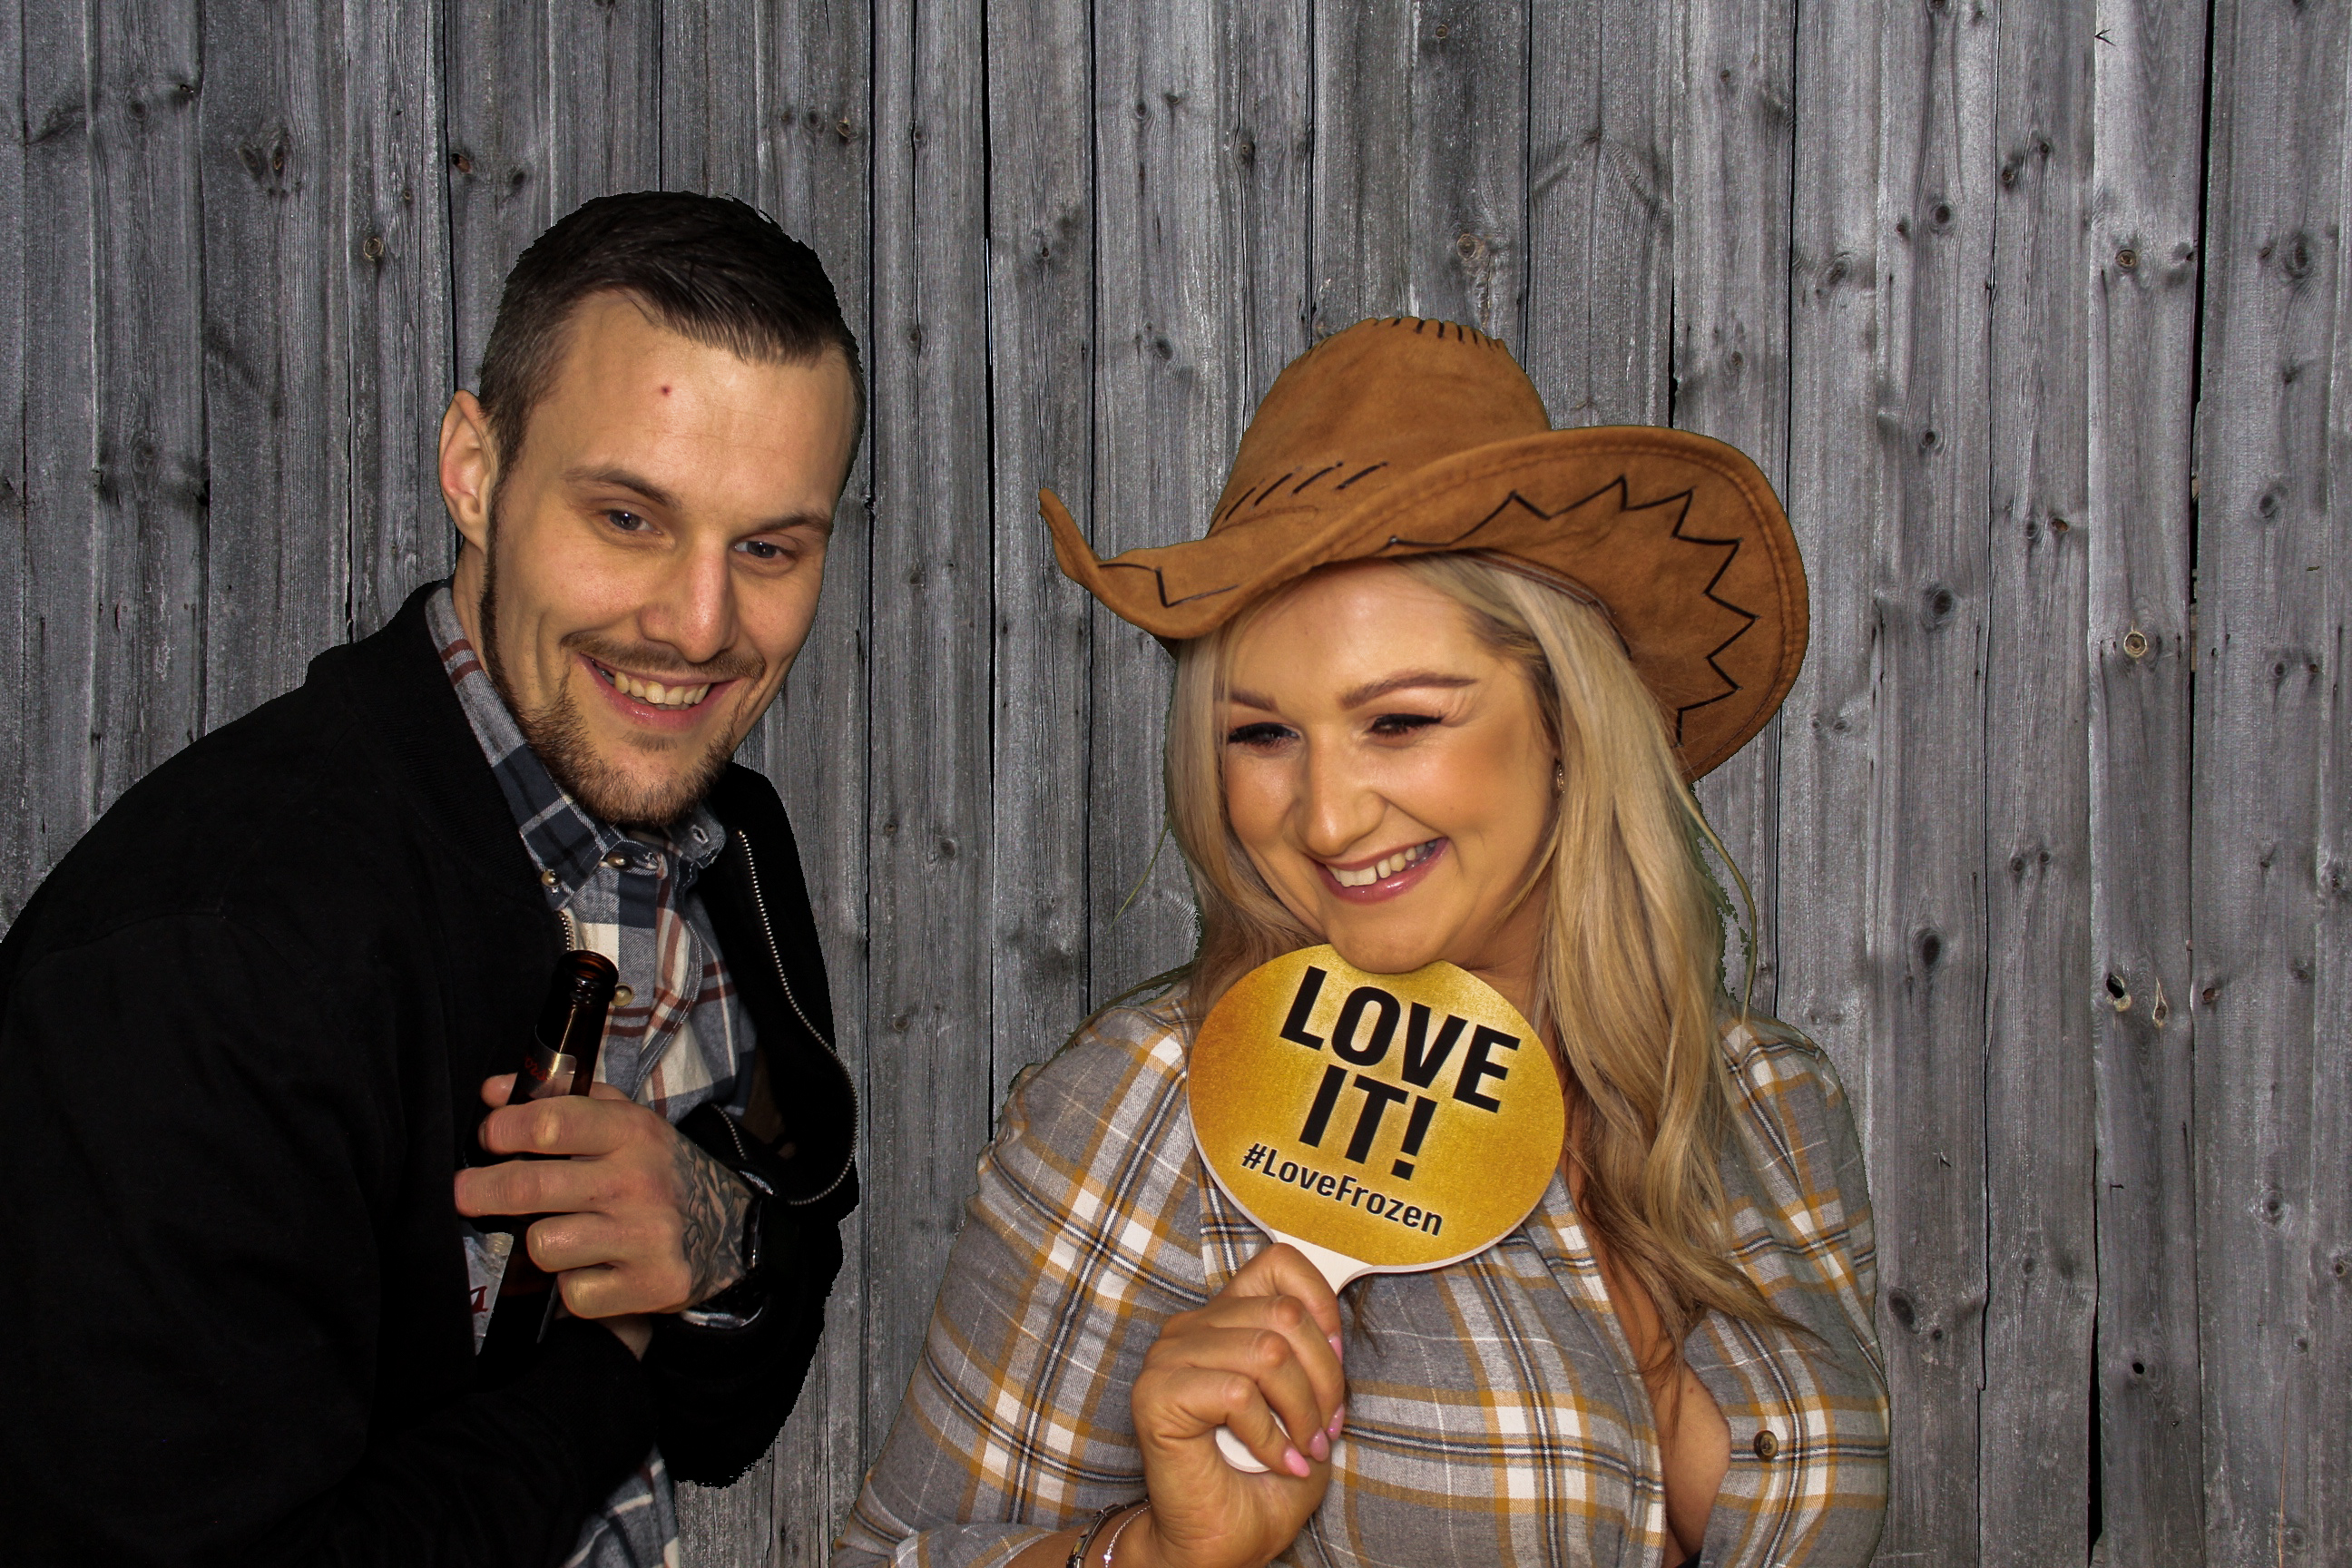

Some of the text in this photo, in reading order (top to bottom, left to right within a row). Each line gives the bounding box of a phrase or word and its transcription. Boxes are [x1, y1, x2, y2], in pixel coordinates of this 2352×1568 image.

[1279, 965, 1521, 1113] LOVE
[1298, 1063, 1438, 1181] IT!
[1240, 1142, 1444, 1237] #LoveFrozen
